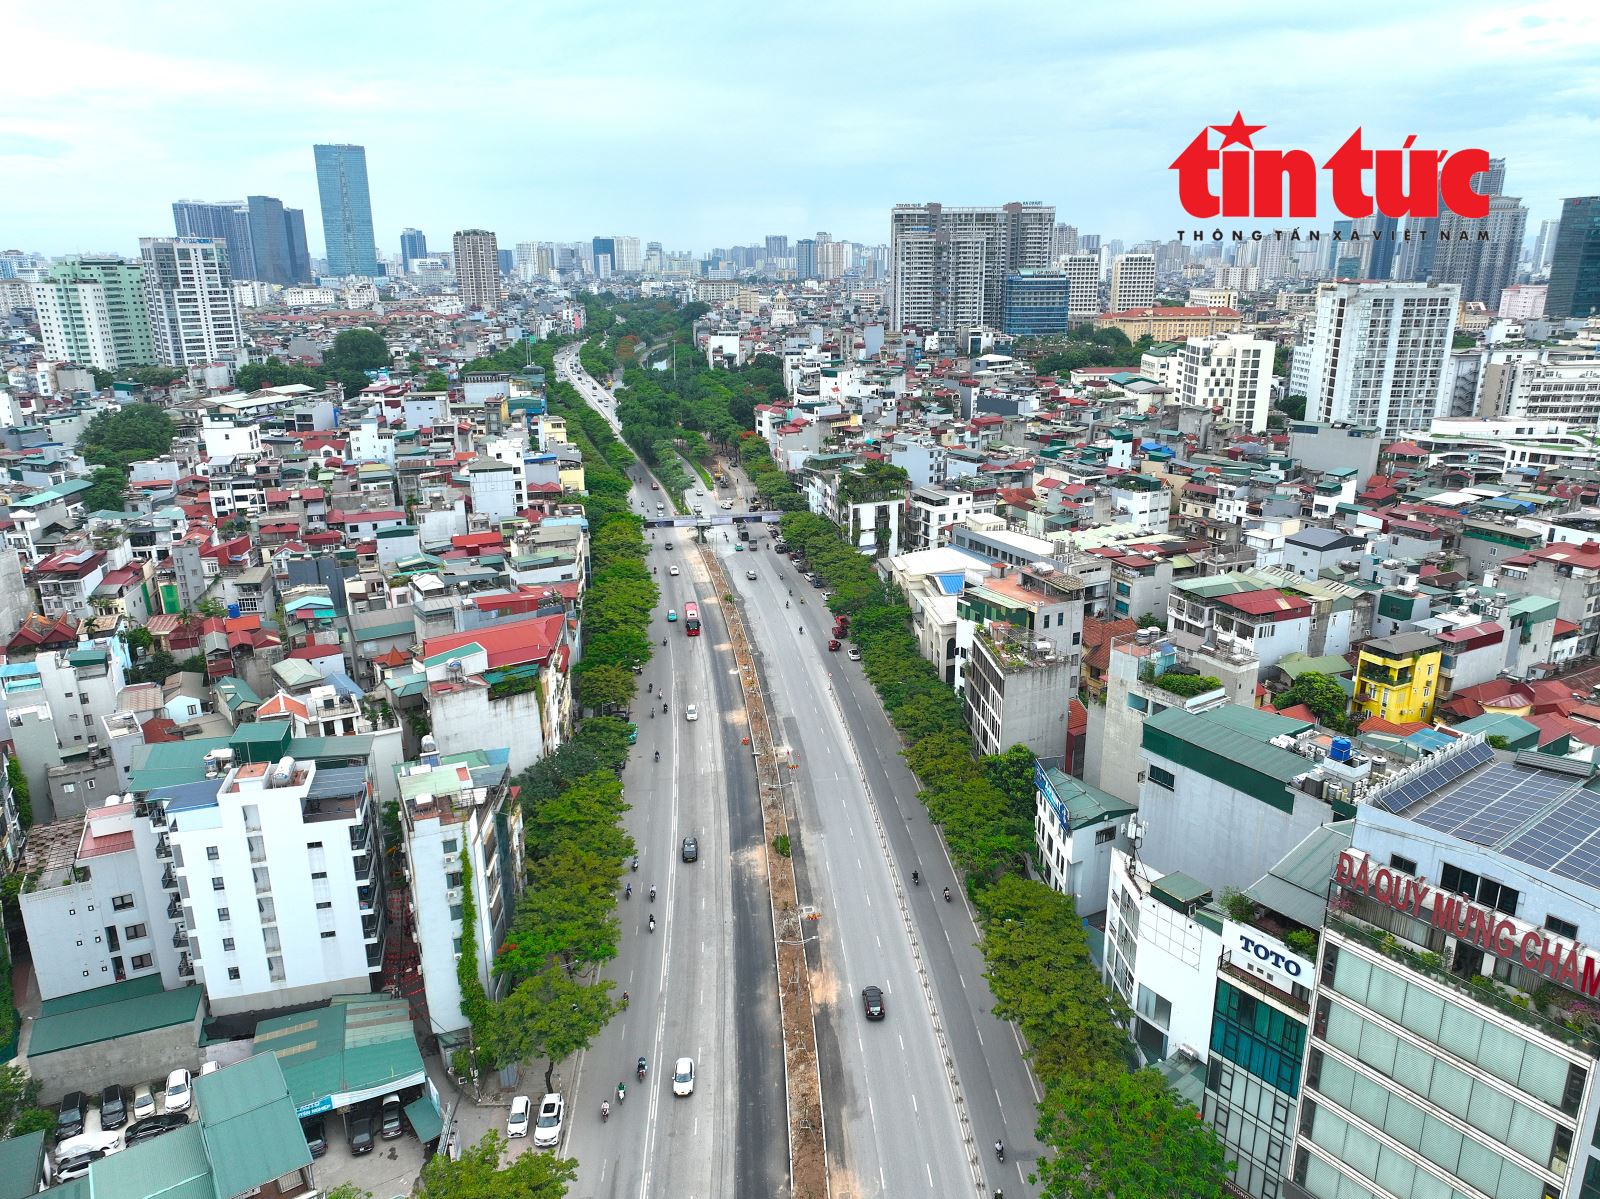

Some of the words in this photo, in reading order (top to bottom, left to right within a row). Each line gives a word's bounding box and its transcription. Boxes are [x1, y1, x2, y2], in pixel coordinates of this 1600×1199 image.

[1335, 851, 1371, 896] ĐÁ
[1374, 868, 1430, 918] QUÝ
[1431, 891, 1517, 958] MỪNG
[1239, 935, 1302, 977] TOTO
